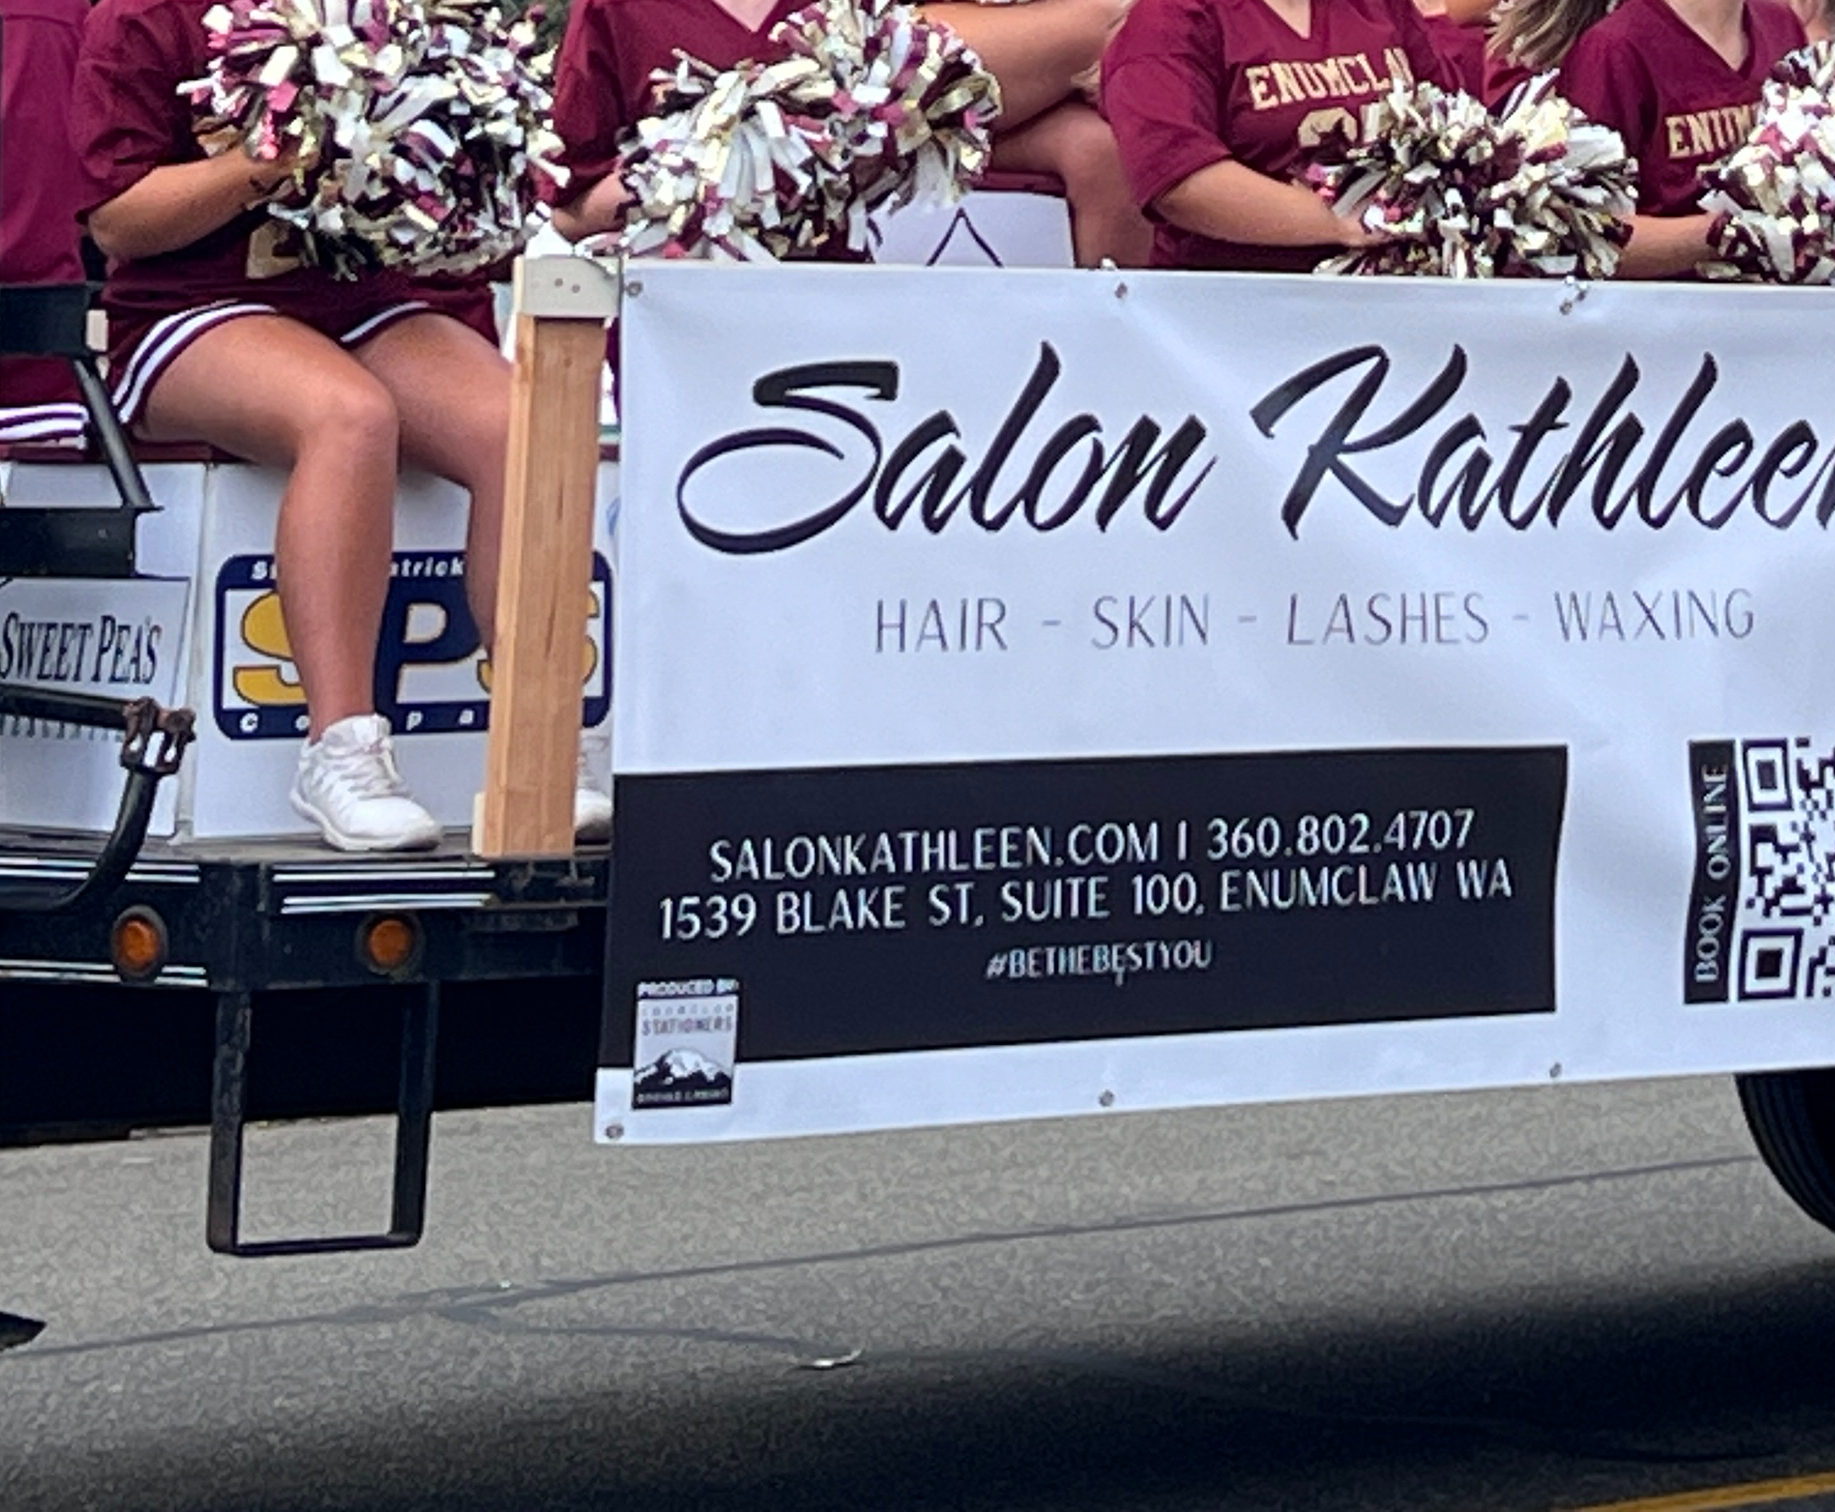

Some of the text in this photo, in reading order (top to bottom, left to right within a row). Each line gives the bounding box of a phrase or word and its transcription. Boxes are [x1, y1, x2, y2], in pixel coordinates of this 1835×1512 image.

[676, 341, 1217, 555] Salon
[0, 611, 93, 680] SWEET
[874, 597, 1008, 653] HAIR
[1092, 594, 1209, 649] SKIN
[1286, 592, 1490, 646] LASHES
[1554, 589, 1755, 642] WAXING
[709, 820, 1160, 883] SALONKATHLEEN.COM
[1206, 808, 1476, 861] 360.802.4707
[1694, 764, 1731, 982] BOOK ONLINE
[659, 893, 757, 940] 1539
[775, 883, 906, 935] BLAKE
[1001, 875, 1110, 923] SUITE
[1219, 860, 1437, 912] ENUMCLAW
[1456, 858, 1513, 899] WA
[986, 938, 1212, 982] #BETHEBESTYOU
